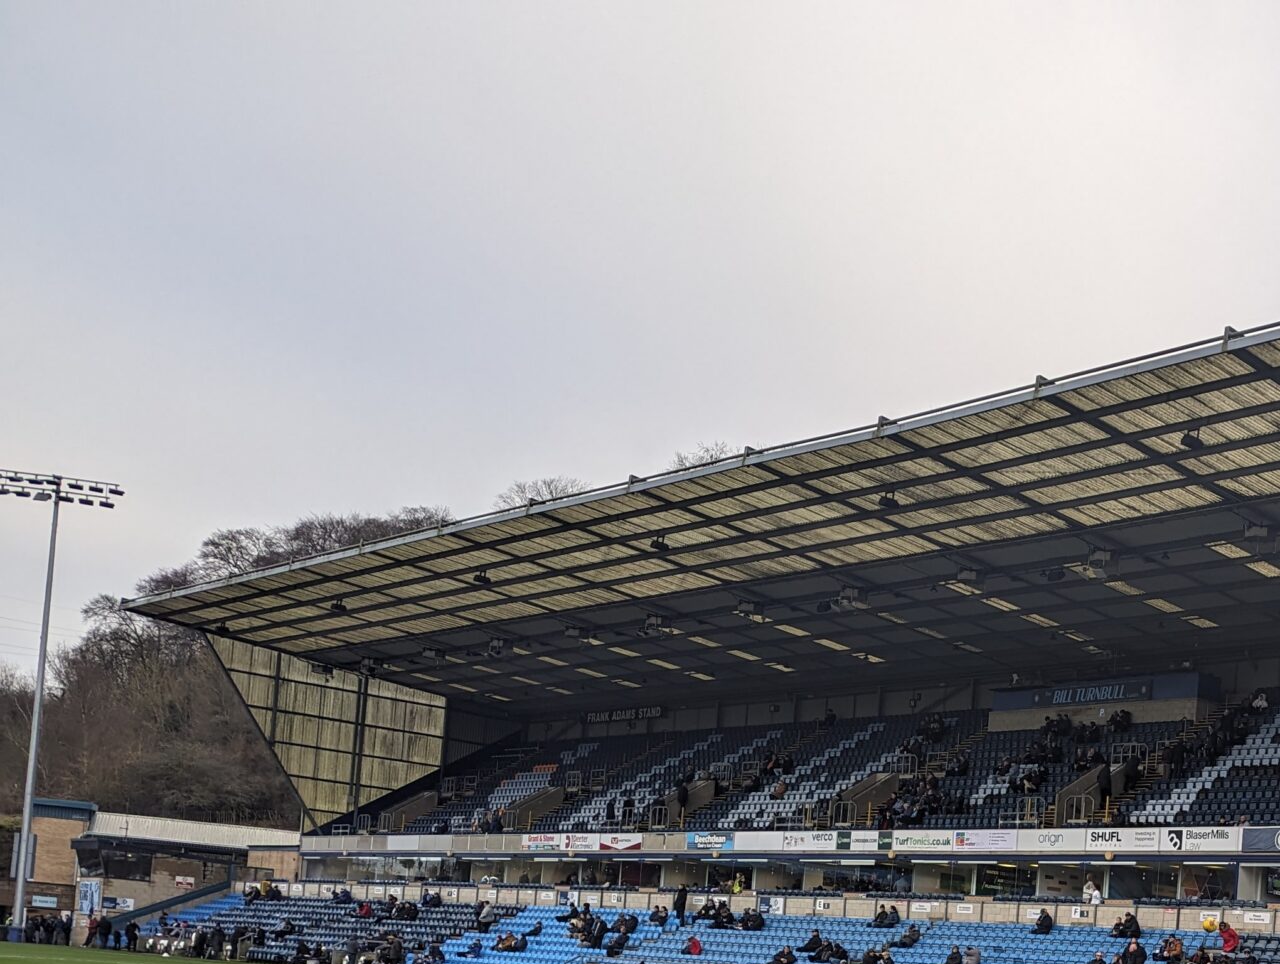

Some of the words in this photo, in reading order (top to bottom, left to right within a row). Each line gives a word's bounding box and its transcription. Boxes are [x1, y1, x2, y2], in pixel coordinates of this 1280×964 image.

[1052, 688, 1073, 704] BILL
[1075, 684, 1126, 701] TURNBULL
[587, 711, 609, 723] FRANK
[611, 708, 636, 721] ADAMS
[638, 706, 661, 719] STAND
[694, 834, 726, 844] Beechdean
[812, 833, 834, 842] verco
[895, 836, 951, 846] TurfTonics.co.uk
[1038, 831, 1063, 846] origin
[1090, 831, 1122, 842] SHUFL
